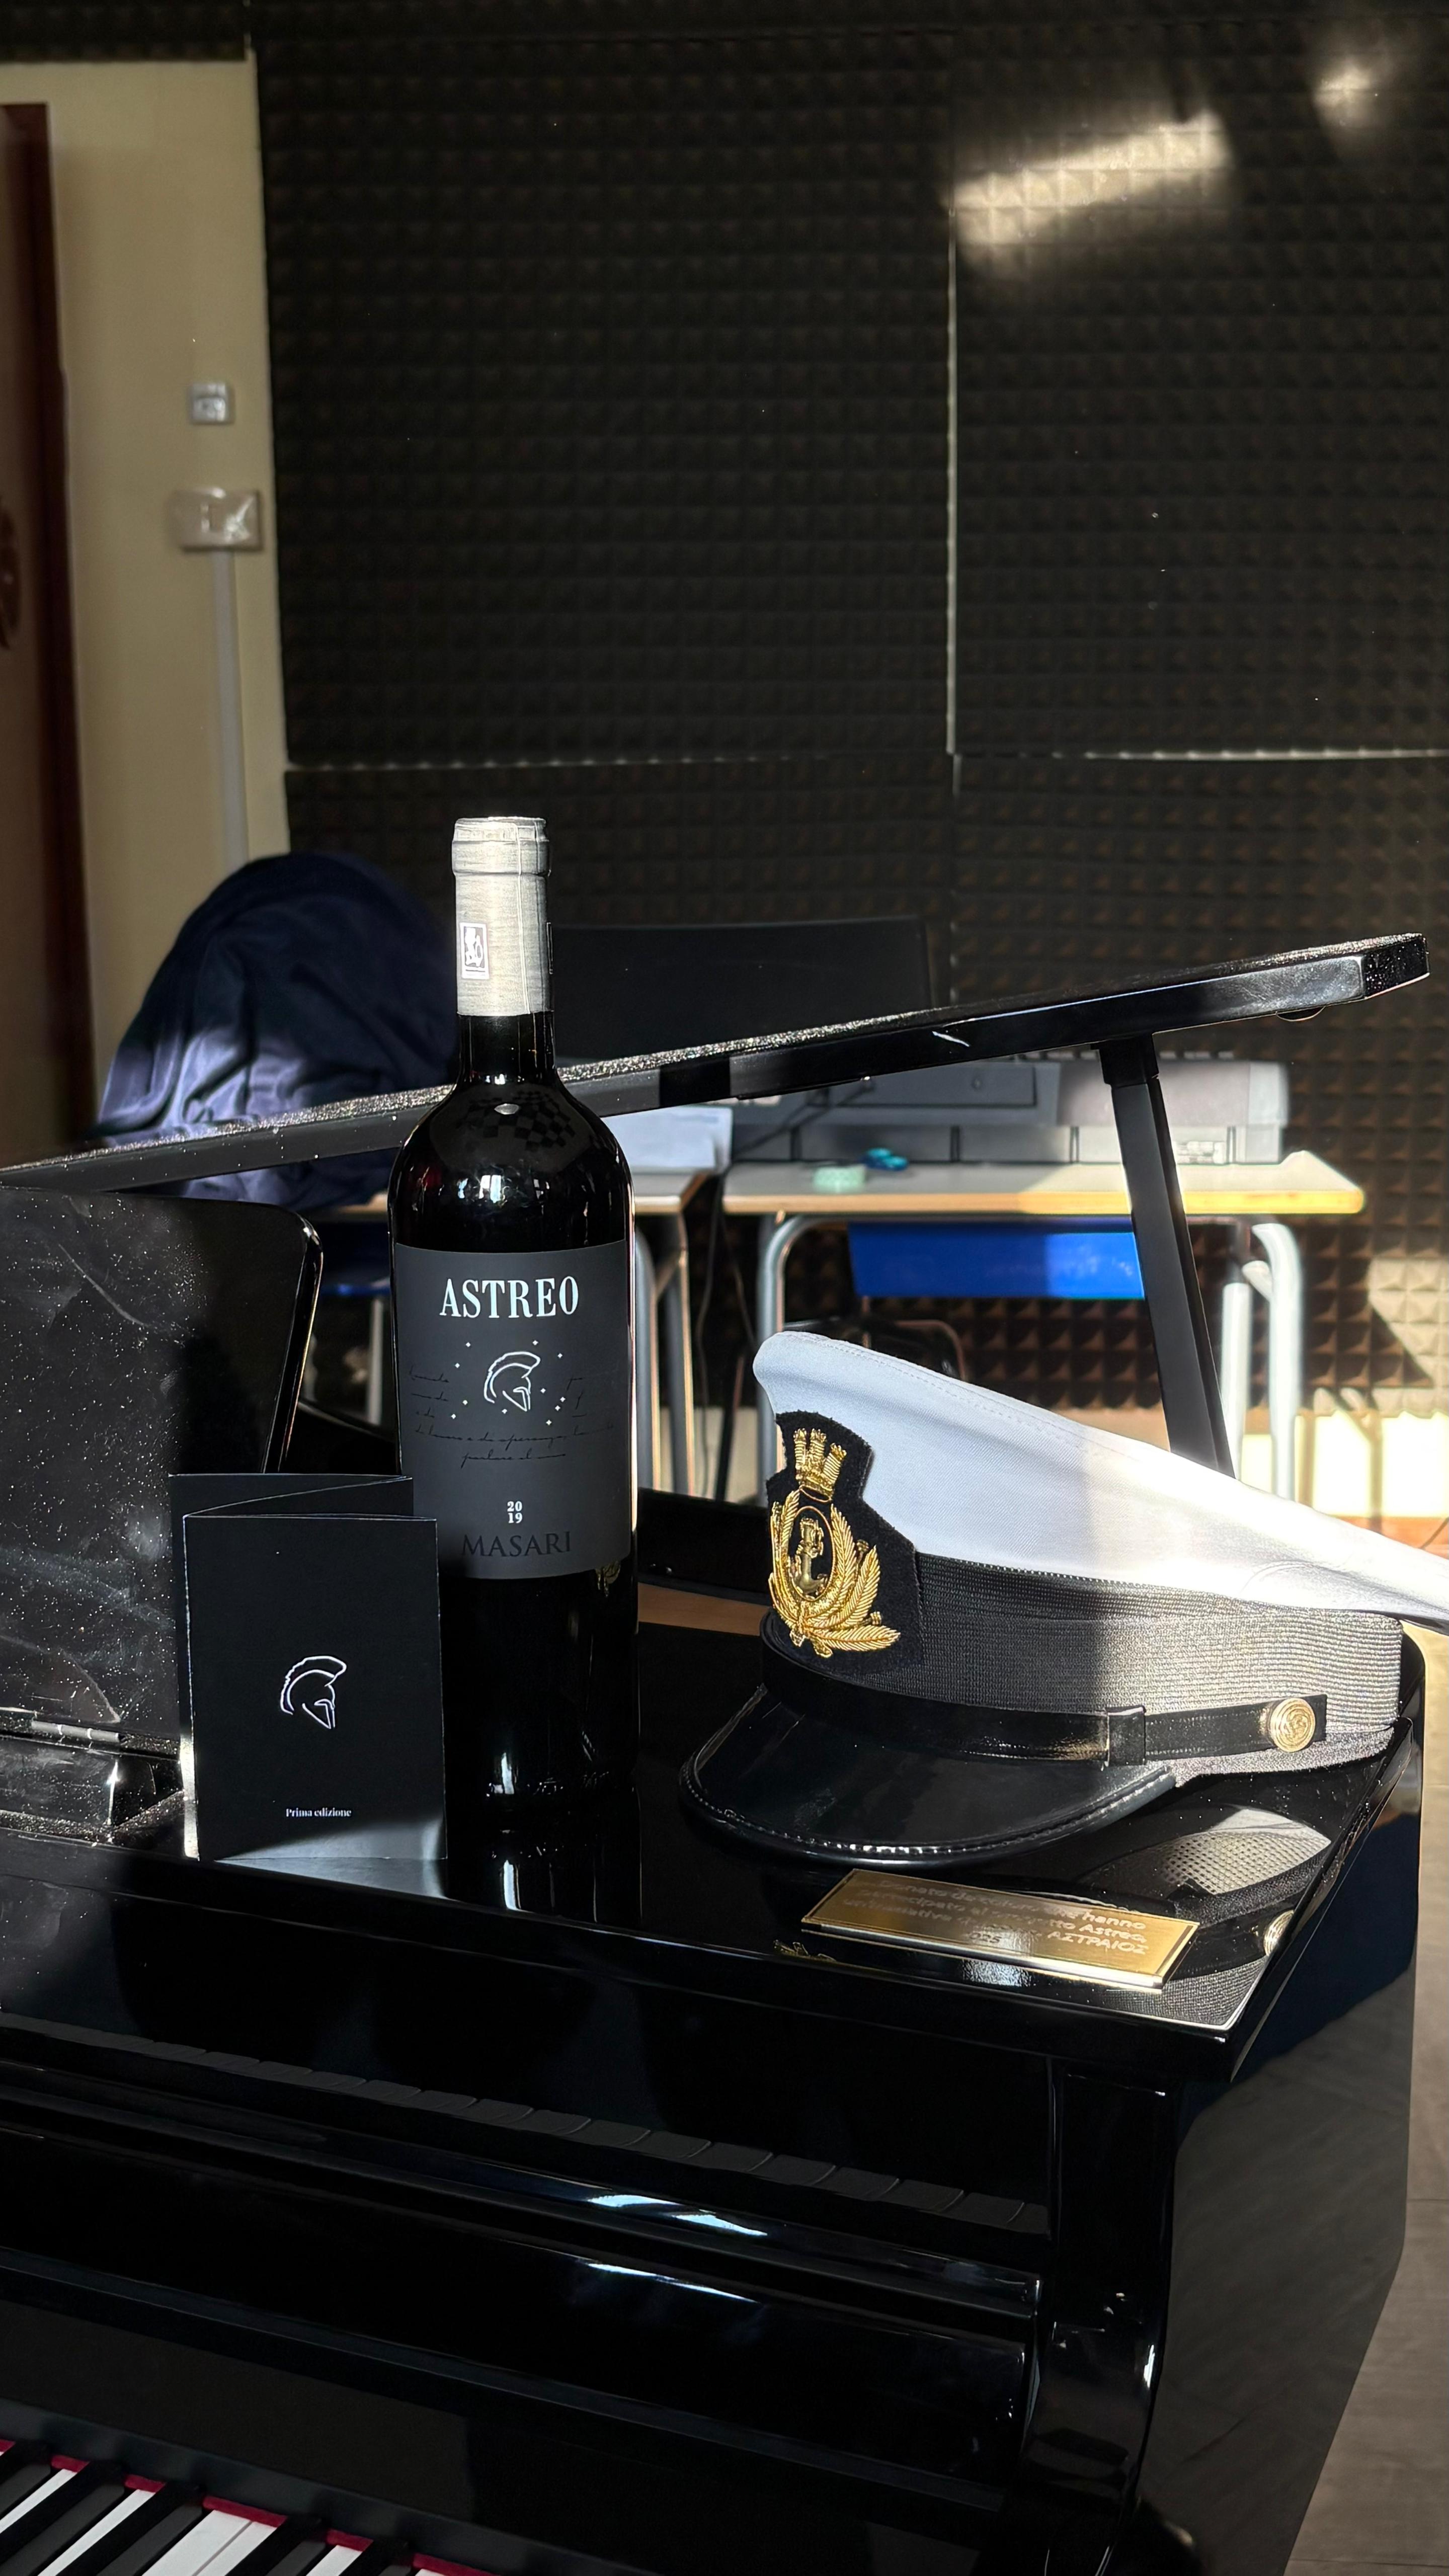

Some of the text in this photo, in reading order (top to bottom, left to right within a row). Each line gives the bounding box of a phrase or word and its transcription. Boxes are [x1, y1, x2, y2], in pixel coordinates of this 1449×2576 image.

[439, 1276, 579, 1318] ASTREO
[507, 1501, 523, 1512] 20
[508, 1512, 523, 1523] 19
[461, 1531, 571, 1557] MASARI
[286, 1807, 352, 1817] Prima edizione
[1081, 1909, 1147, 1930] hanno
[962, 1930, 1003, 1944] 025
